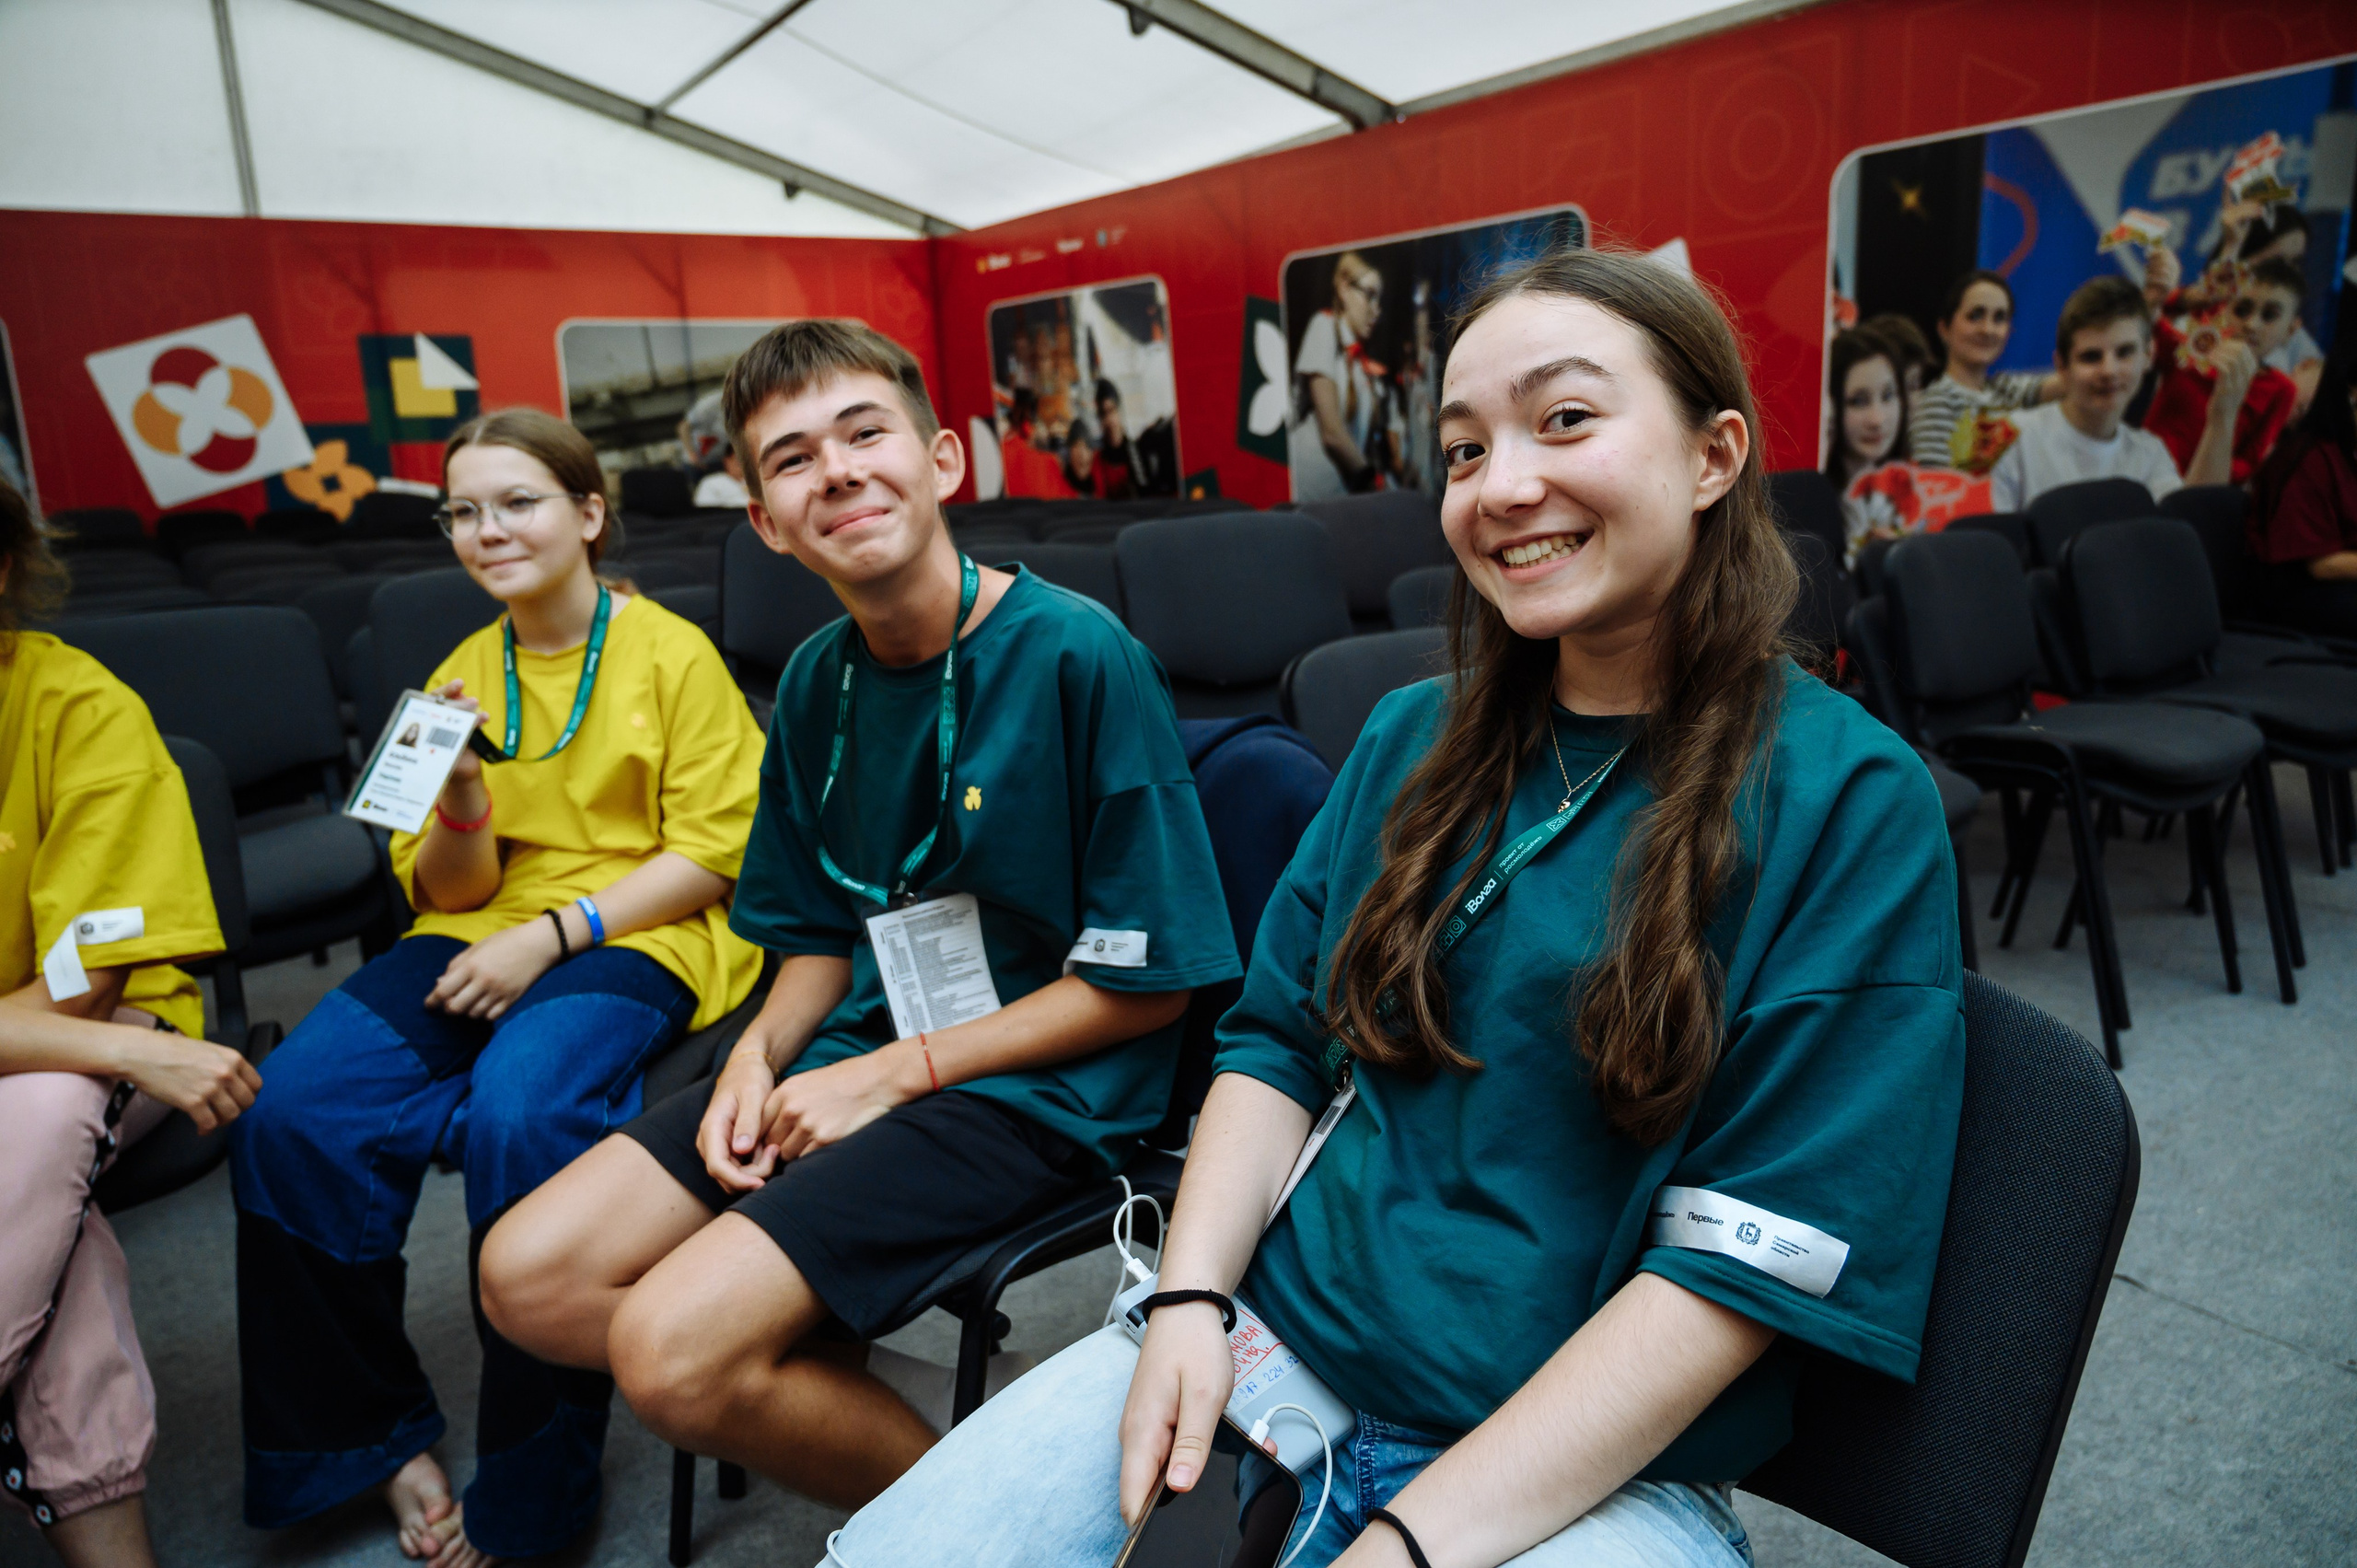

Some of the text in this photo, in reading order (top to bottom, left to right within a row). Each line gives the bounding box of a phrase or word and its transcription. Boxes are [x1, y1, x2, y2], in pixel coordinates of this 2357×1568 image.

[1499, 842, 1525, 868] проект от
[1504, 836, 1542, 875] росмолодёжь
[1465, 877, 1497, 914] iВолга
[1687, 1211, 1724, 1226] Первые
